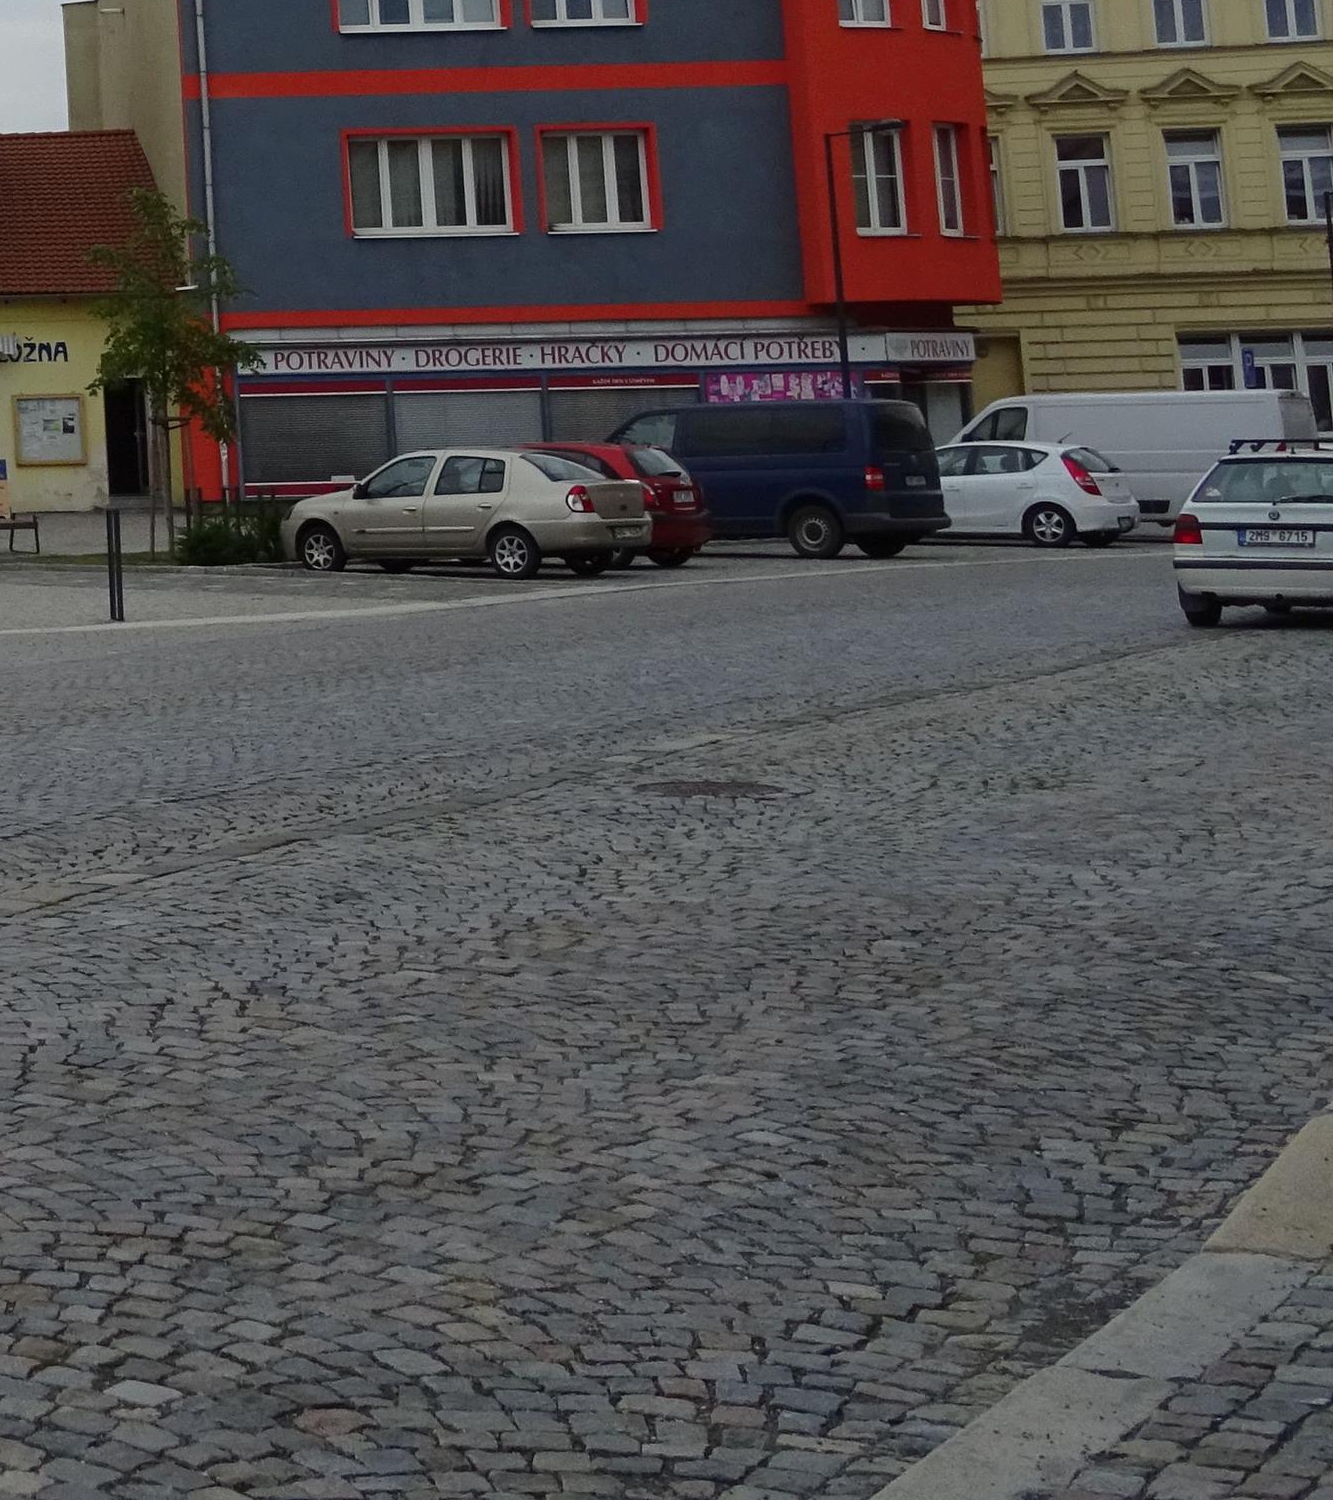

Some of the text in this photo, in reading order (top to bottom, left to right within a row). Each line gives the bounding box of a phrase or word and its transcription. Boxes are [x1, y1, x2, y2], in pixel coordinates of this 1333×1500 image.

[273, 349, 396, 370] POTRAVINY
[414, 347, 523, 368] DROGERIE
[539, 341, 627, 366] HRAČKY
[653, 338, 745, 363] DOMÁCÍ
[910, 339, 971, 358] POTRAVINY
[1278, 531, 1309, 542] 6715
